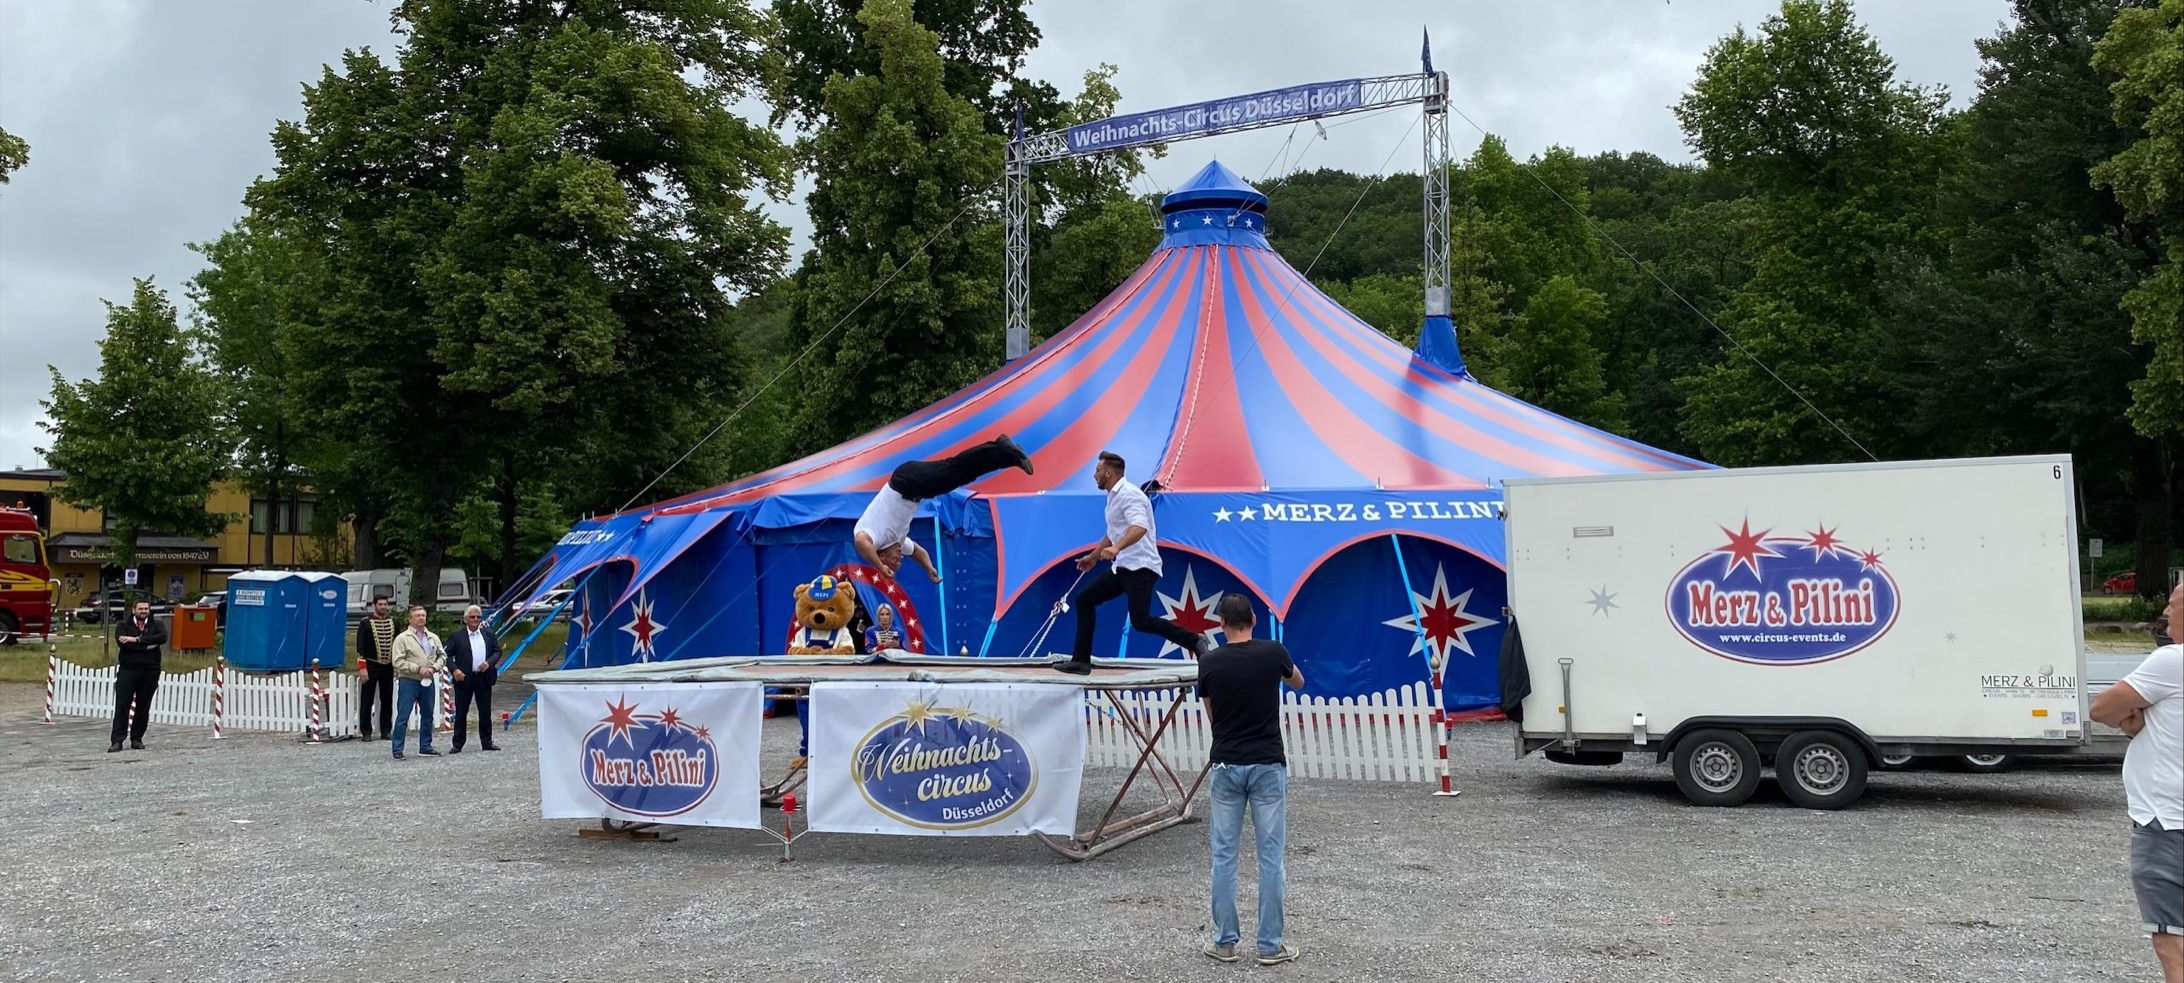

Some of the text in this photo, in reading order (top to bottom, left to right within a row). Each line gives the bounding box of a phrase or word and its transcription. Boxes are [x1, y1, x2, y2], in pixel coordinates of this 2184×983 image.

[1074, 86, 1355, 148] Weihnachts-Circus Düsseldorf
[2053, 464, 2062, 480] 6
[1261, 502, 1358, 522] MERZ
[1362, 503, 1382, 522] &
[168, 552, 182, 560] von
[1689, 581, 1874, 625] Merz & Pilini
[1719, 632, 1847, 643] www.circus-events.de
[1981, 675, 2076, 688] MERZ & PILINI
[590, 749, 706, 786] Merz & Pilini
[856, 735, 1013, 784] Weihnachts-
[917, 767, 992, 802] circus
[942, 787, 1015, 821] Düsseldorf
